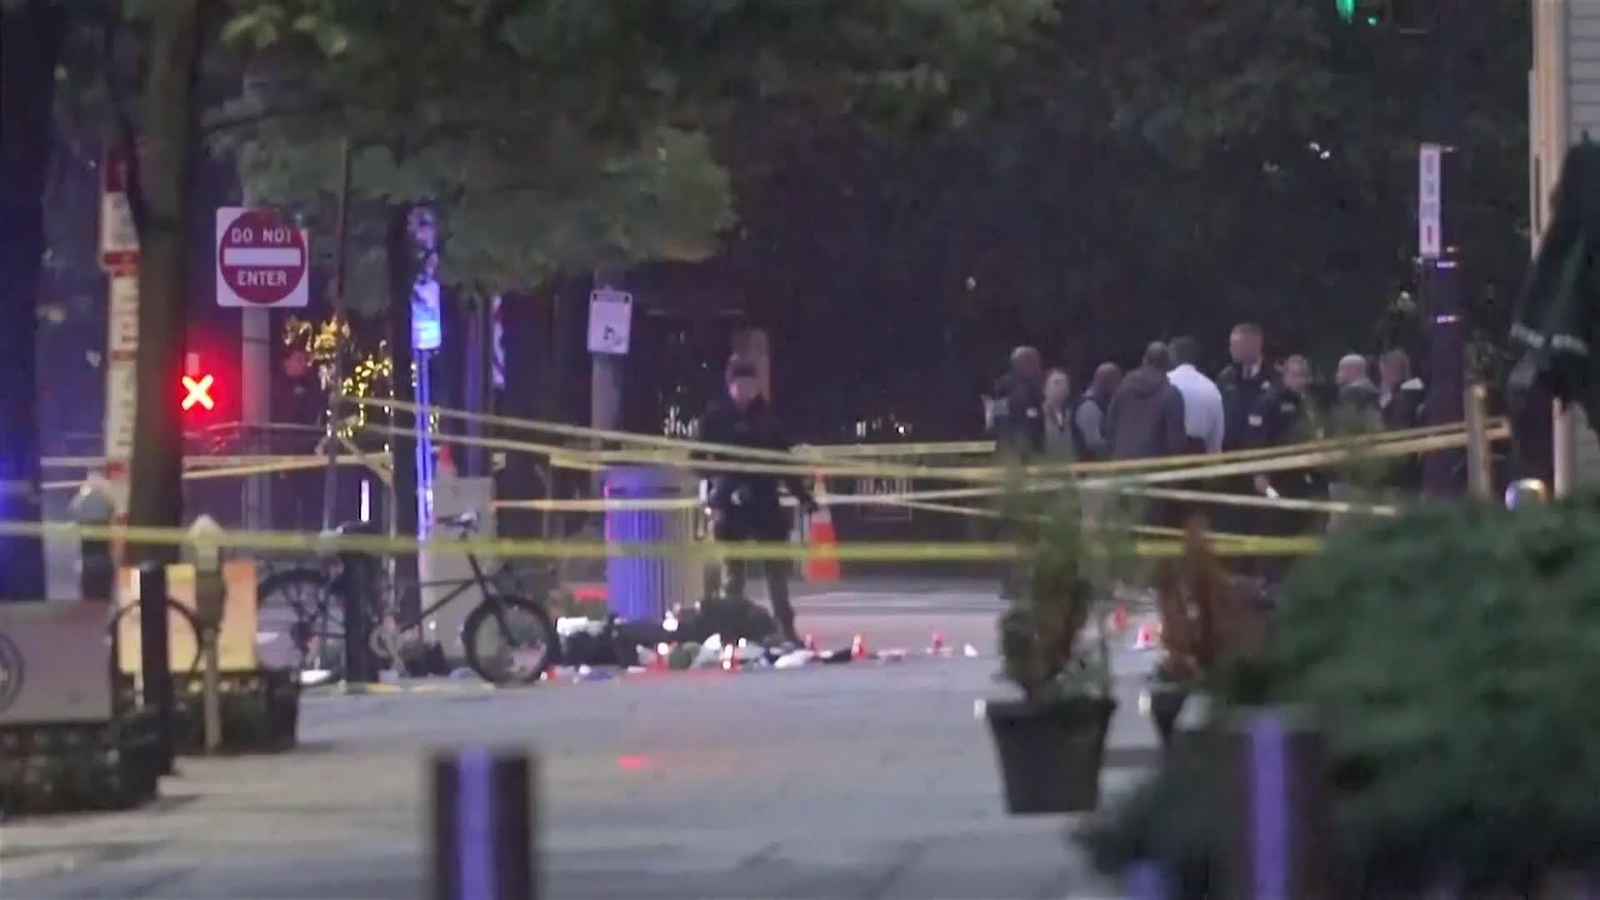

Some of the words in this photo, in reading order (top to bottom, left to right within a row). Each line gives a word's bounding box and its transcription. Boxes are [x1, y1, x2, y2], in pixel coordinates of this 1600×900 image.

[231, 227, 253, 243] DO
[262, 227, 292, 243] NOT
[237, 270, 287, 286] ENTER
